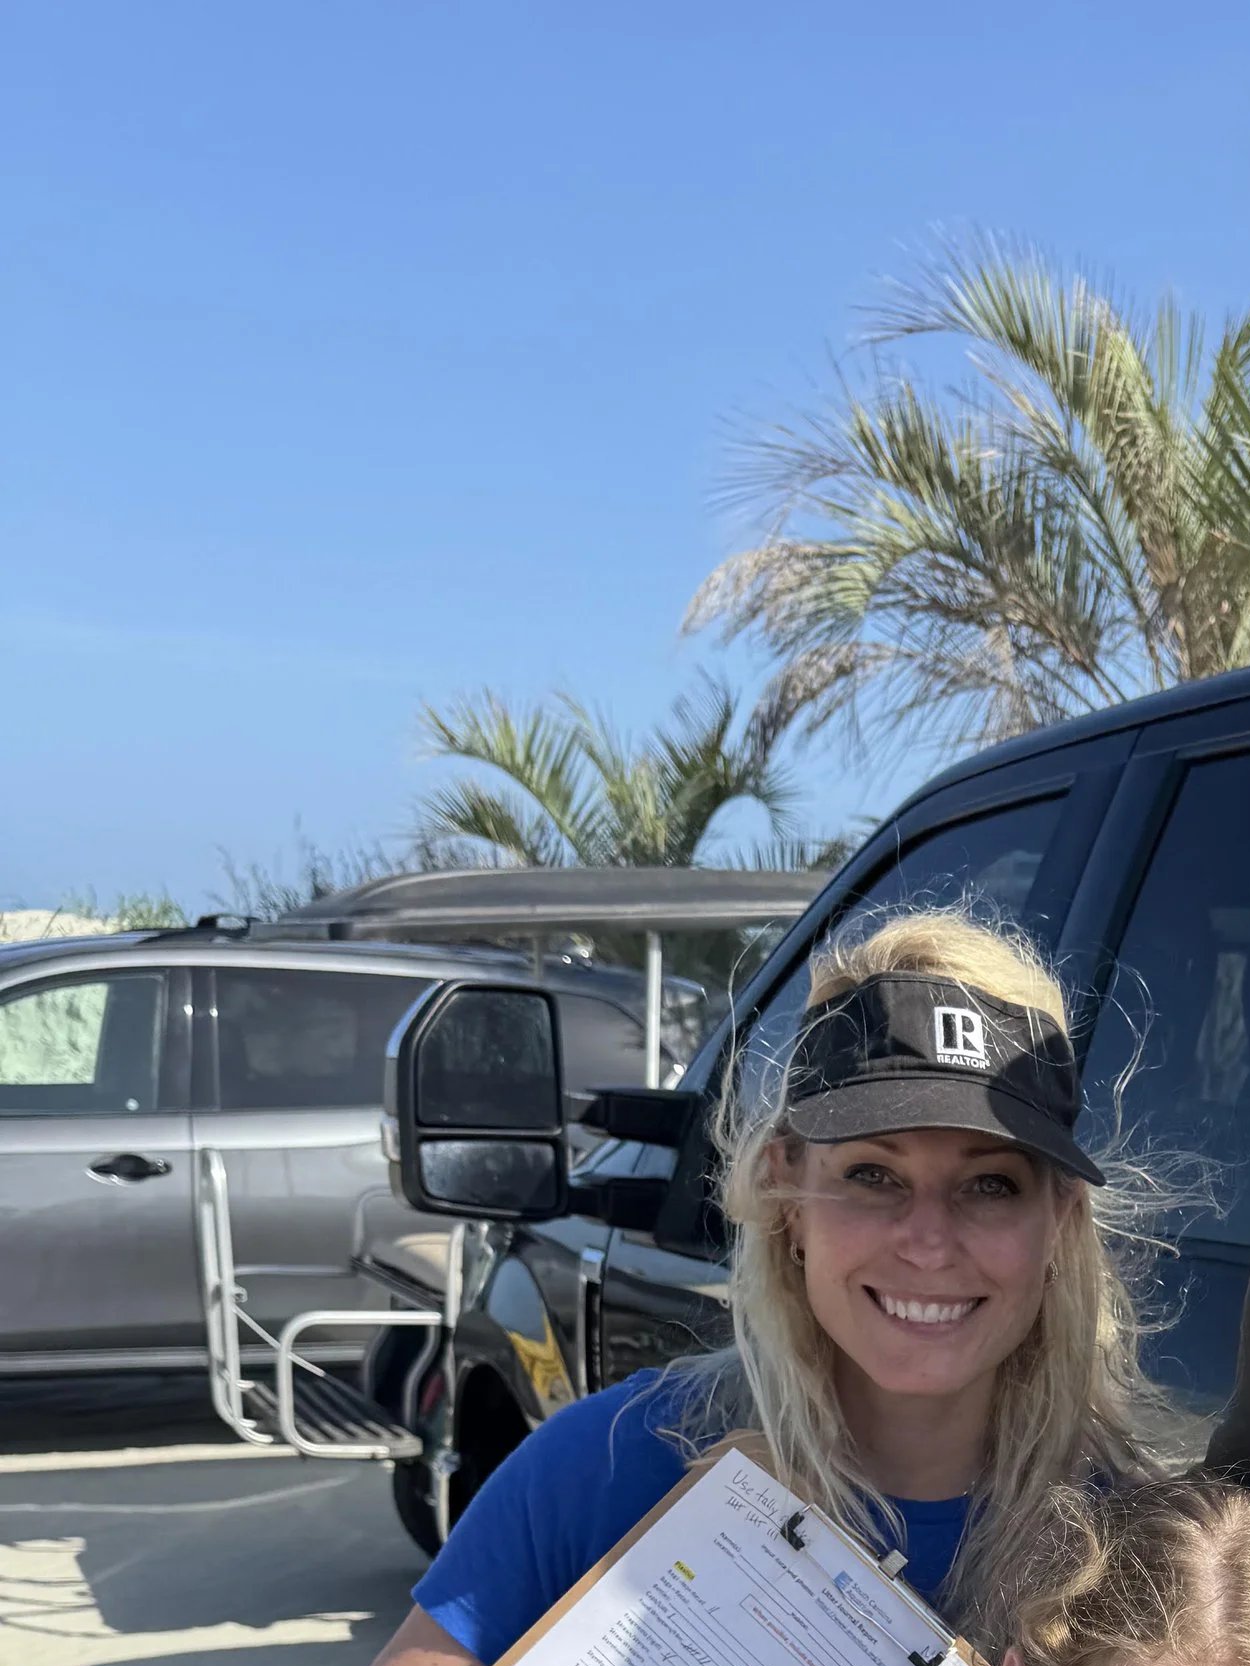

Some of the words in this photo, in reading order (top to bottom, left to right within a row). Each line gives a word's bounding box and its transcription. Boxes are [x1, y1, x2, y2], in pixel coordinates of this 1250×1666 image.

[729, 1467, 759, 1498] Use
[751, 1484, 785, 1518] tally
[820, 1586, 839, 1606] Litter
[835, 1601, 860, 1627] Journal
[855, 1622, 879, 1646] Report
[850, 1581, 871, 1603] South
[866, 1598, 894, 1625] Carolina
